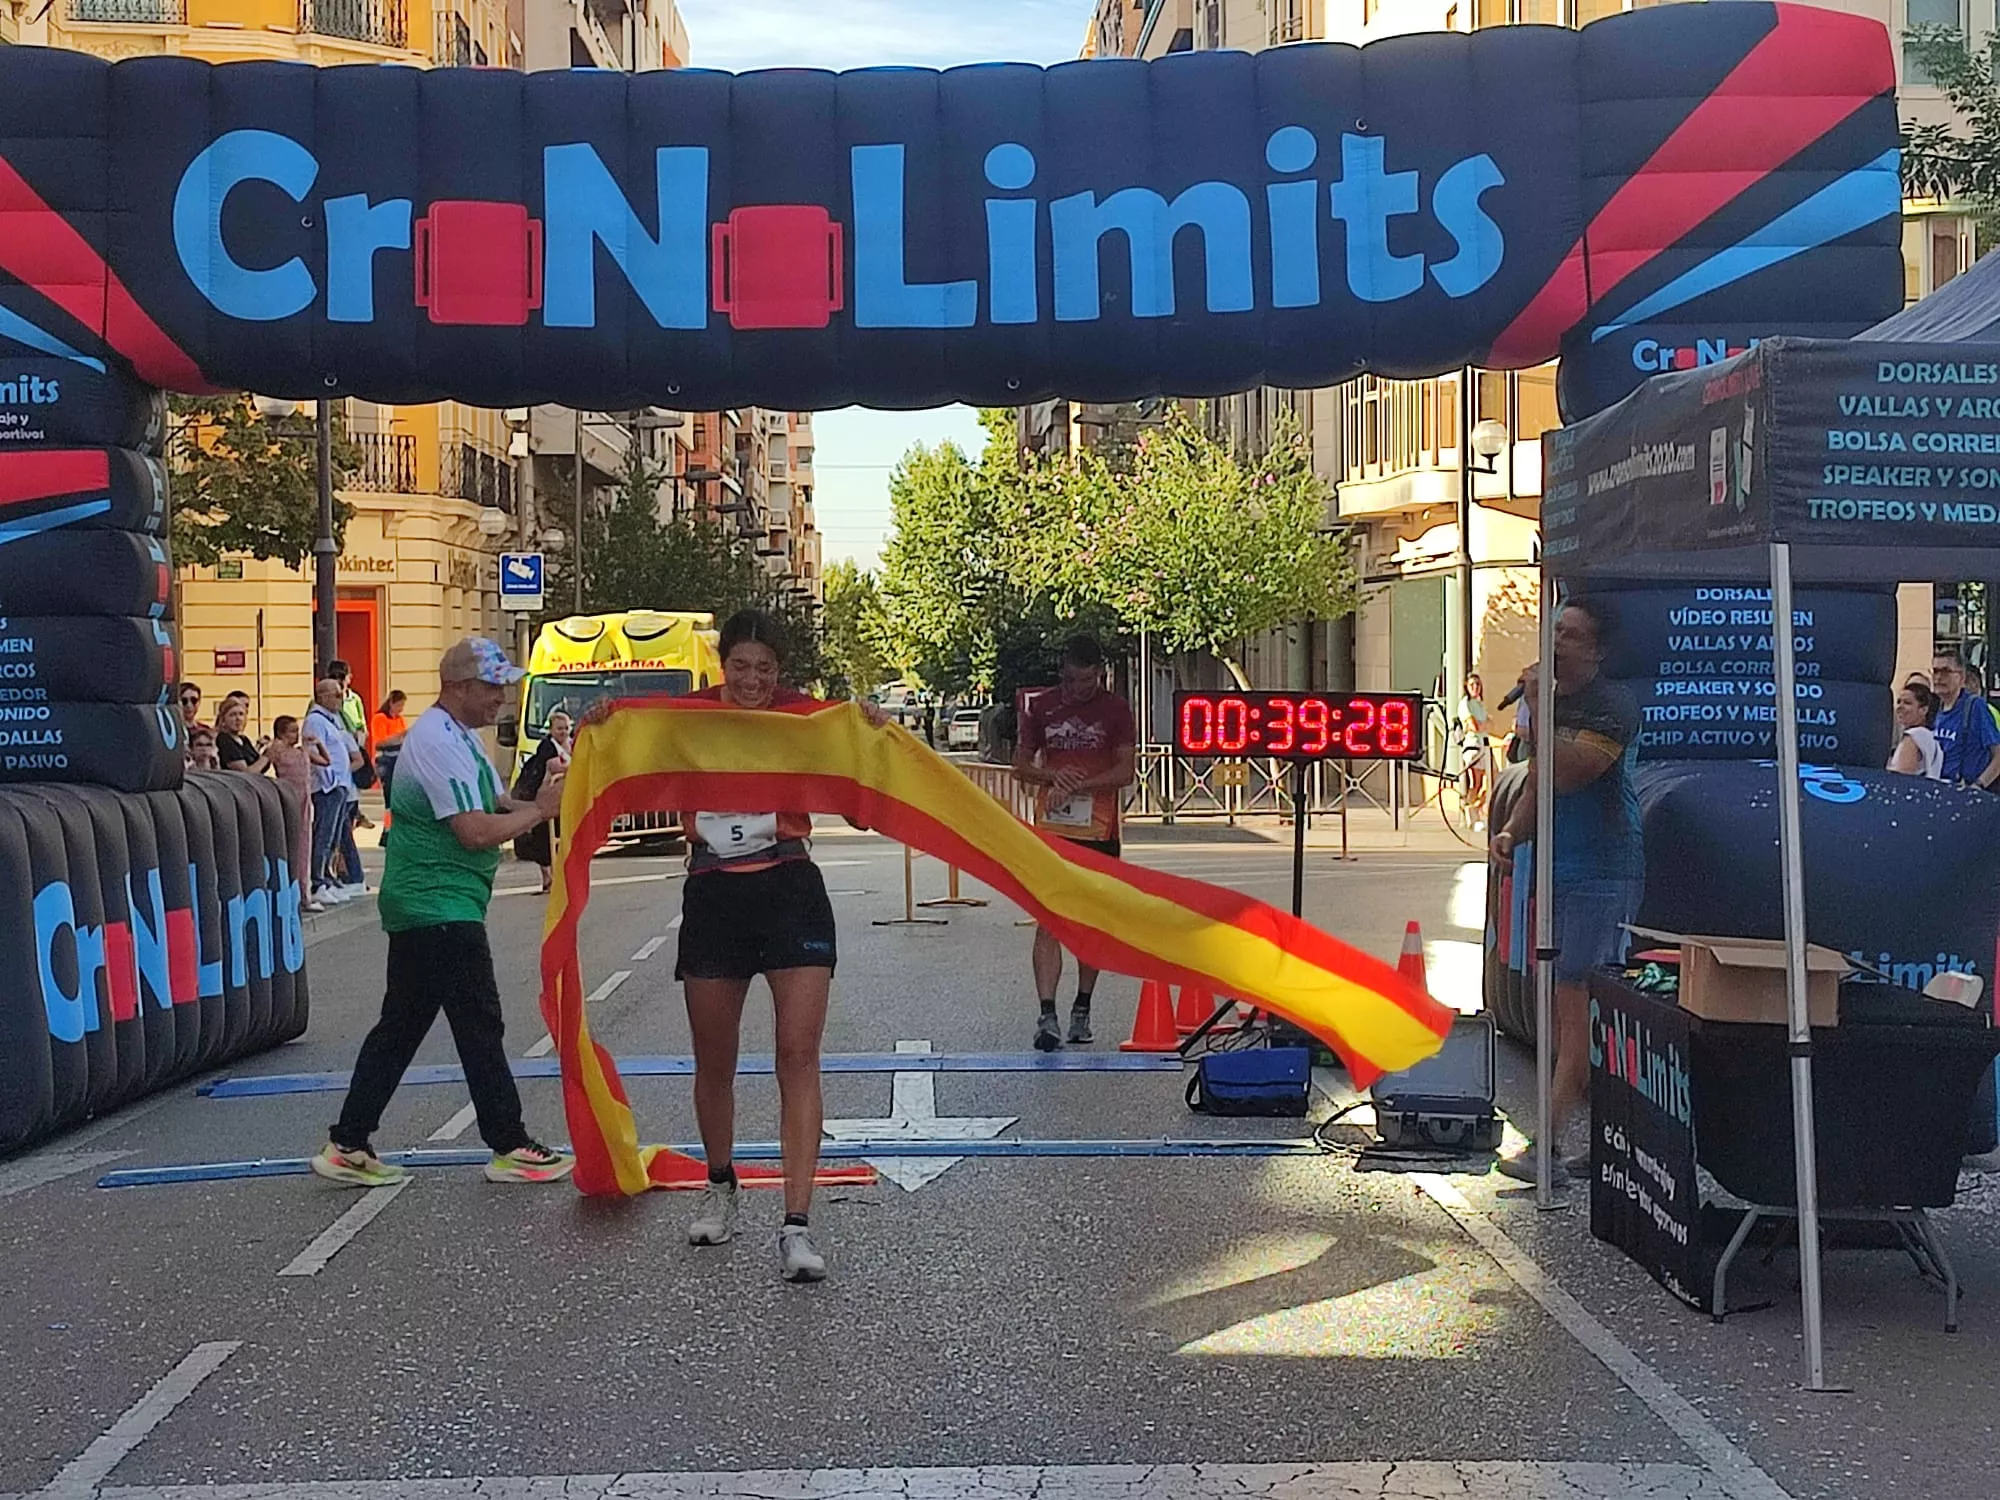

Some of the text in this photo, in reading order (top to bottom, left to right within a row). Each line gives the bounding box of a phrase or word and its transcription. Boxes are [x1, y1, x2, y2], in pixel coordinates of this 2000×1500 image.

[1877, 361, 1998, 384] DORSALES
[1838, 395, 1930, 418] VALLAS
[1935, 398, 1953, 418] Y
[1827, 430, 1907, 452] BOLSA
[1823, 464, 1931, 487] SPEAKER
[1936, 468, 1954, 487] Y
[1807, 498, 2000, 523] TROFEOS Y MED
[1669, 606, 1814, 626] VÍDEO RESUEN
[1668, 635, 1815, 652] VALLAS Y AOS
[1659, 660, 1716, 675] BOLSA
[1655, 680, 1823, 699] SPEAKER Y SODO
[1183, 698, 1410, 752] 00:39:28
[1642, 705, 1837, 726] TROFEOS Y MEDLLAS
[1641, 730, 1839, 750] CHIP ACTIVO Y SIVO
[5, 754, 68, 770] PASIVO
[730, 825, 744, 842] 5
